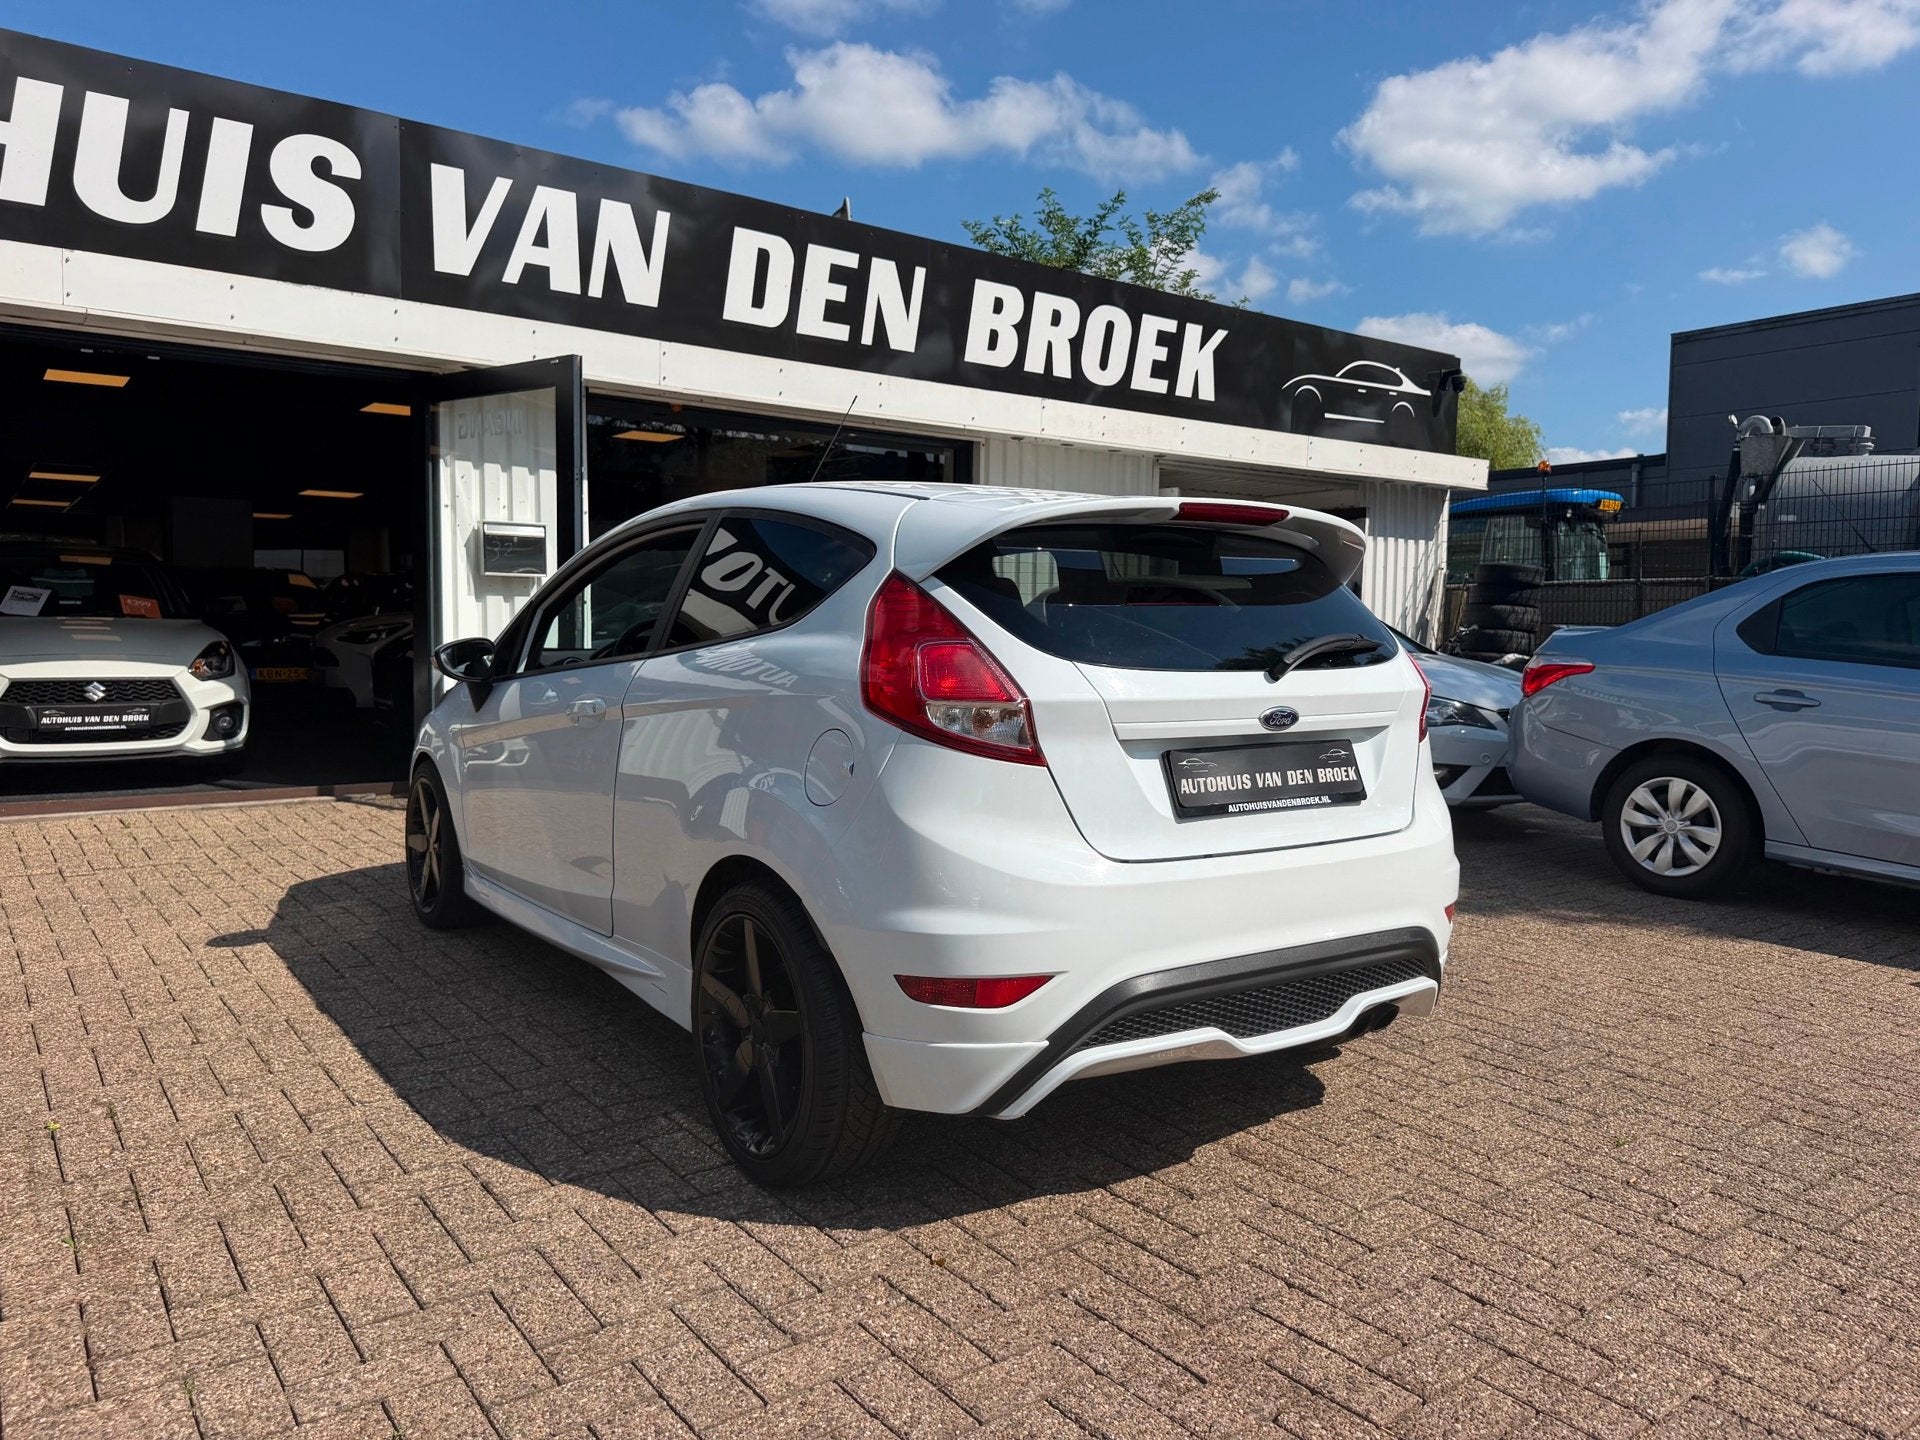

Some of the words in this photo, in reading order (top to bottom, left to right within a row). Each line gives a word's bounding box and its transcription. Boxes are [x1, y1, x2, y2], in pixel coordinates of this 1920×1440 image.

[430, 163, 671, 307] VAN
[722, 226, 926, 353] DEN
[964, 278, 1229, 402] BROEK
[41, 715, 82, 724] AUTOHUIS
[84, 715, 101, 723] VAN
[103, 715, 120, 723] DEN
[122, 714, 150, 722] BROEK
[1270, 711, 1293, 725] Ford
[1180, 774, 1252, 794] AUTOHUIS
[1255, 772, 1283, 789] VAN
[1286, 768, 1314, 786] DEN
[1317, 766, 1358, 782] BROEK
[1228, 795, 1332, 813] AUTOHUISVANDENBROEK.NL
